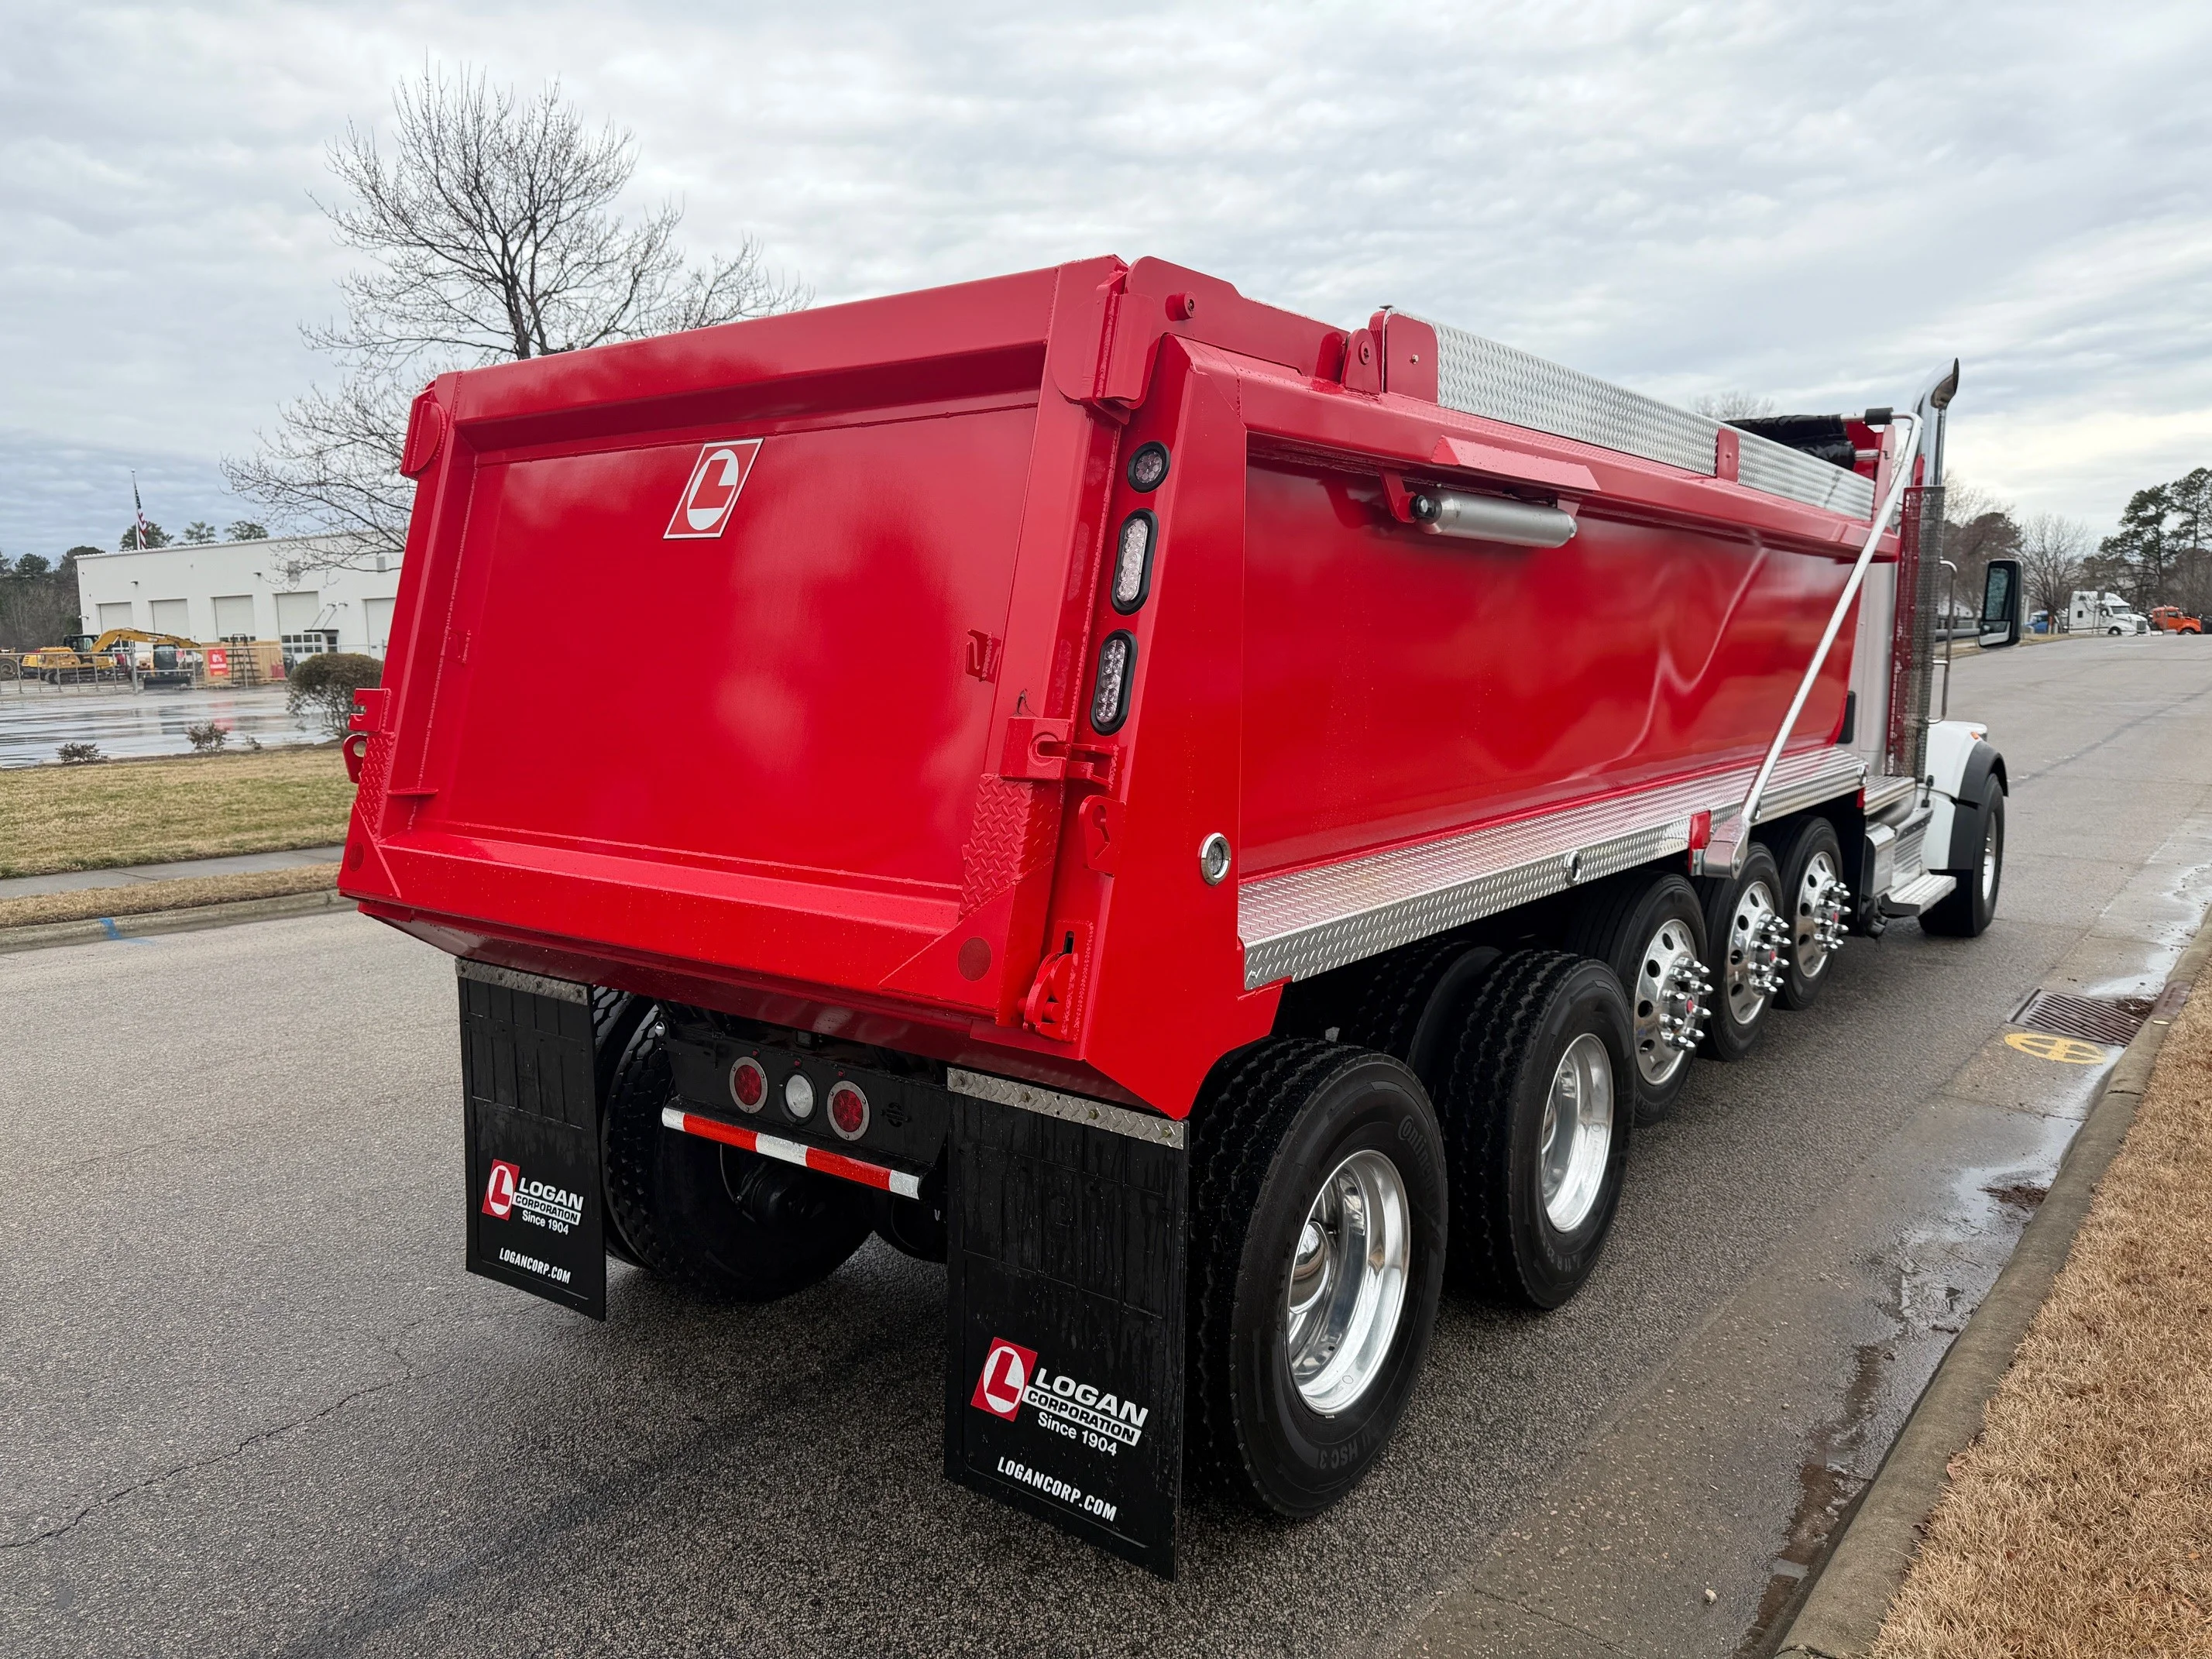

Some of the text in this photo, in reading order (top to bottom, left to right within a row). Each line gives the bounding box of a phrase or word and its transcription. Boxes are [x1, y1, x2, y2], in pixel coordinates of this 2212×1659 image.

[1397, 1114, 1442, 1214] Continent
[515, 1194, 579, 1223] CORPORATION
[518, 1176, 584, 1211] LOGAN
[521, 1210, 569, 1235] Since 1904
[499, 1247, 572, 1284] LOGANCORP.COM
[1027, 1389, 1136, 1442] CORPORATION
[1035, 1367, 1149, 1427] LOGAN
[1037, 1411, 1118, 1456] Since 1904
[997, 1456, 1118, 1522] LOGANCORP.COM
